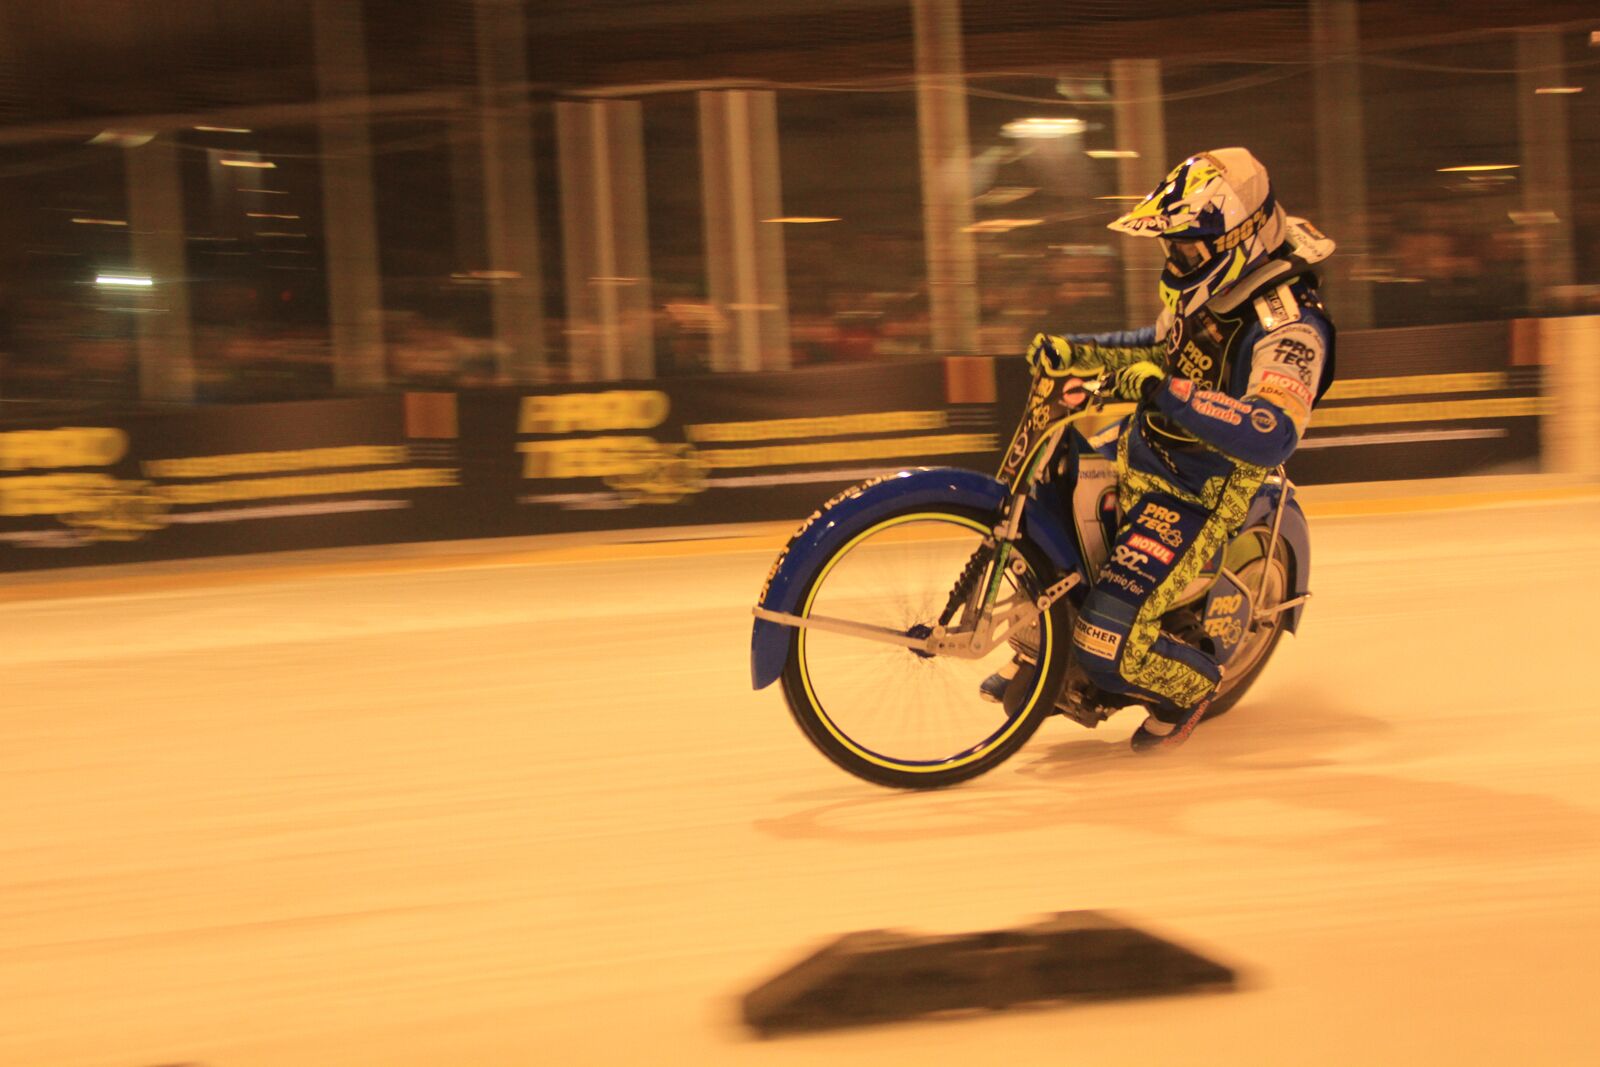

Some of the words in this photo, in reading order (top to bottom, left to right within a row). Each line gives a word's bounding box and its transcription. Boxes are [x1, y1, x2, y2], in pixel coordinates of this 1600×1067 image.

[1183, 340, 1213, 371] PRO
[1273, 349, 1307, 370] TEC
[1278, 338, 1315, 361] PRO
[1176, 352, 1203, 381] TEC
[1135, 514, 1170, 535] TEC
[1144, 503, 1181, 524] PRO
[1128, 534, 1173, 563] MOTUL
[1208, 594, 1242, 617] PRO
[1203, 617, 1231, 637] TEC
